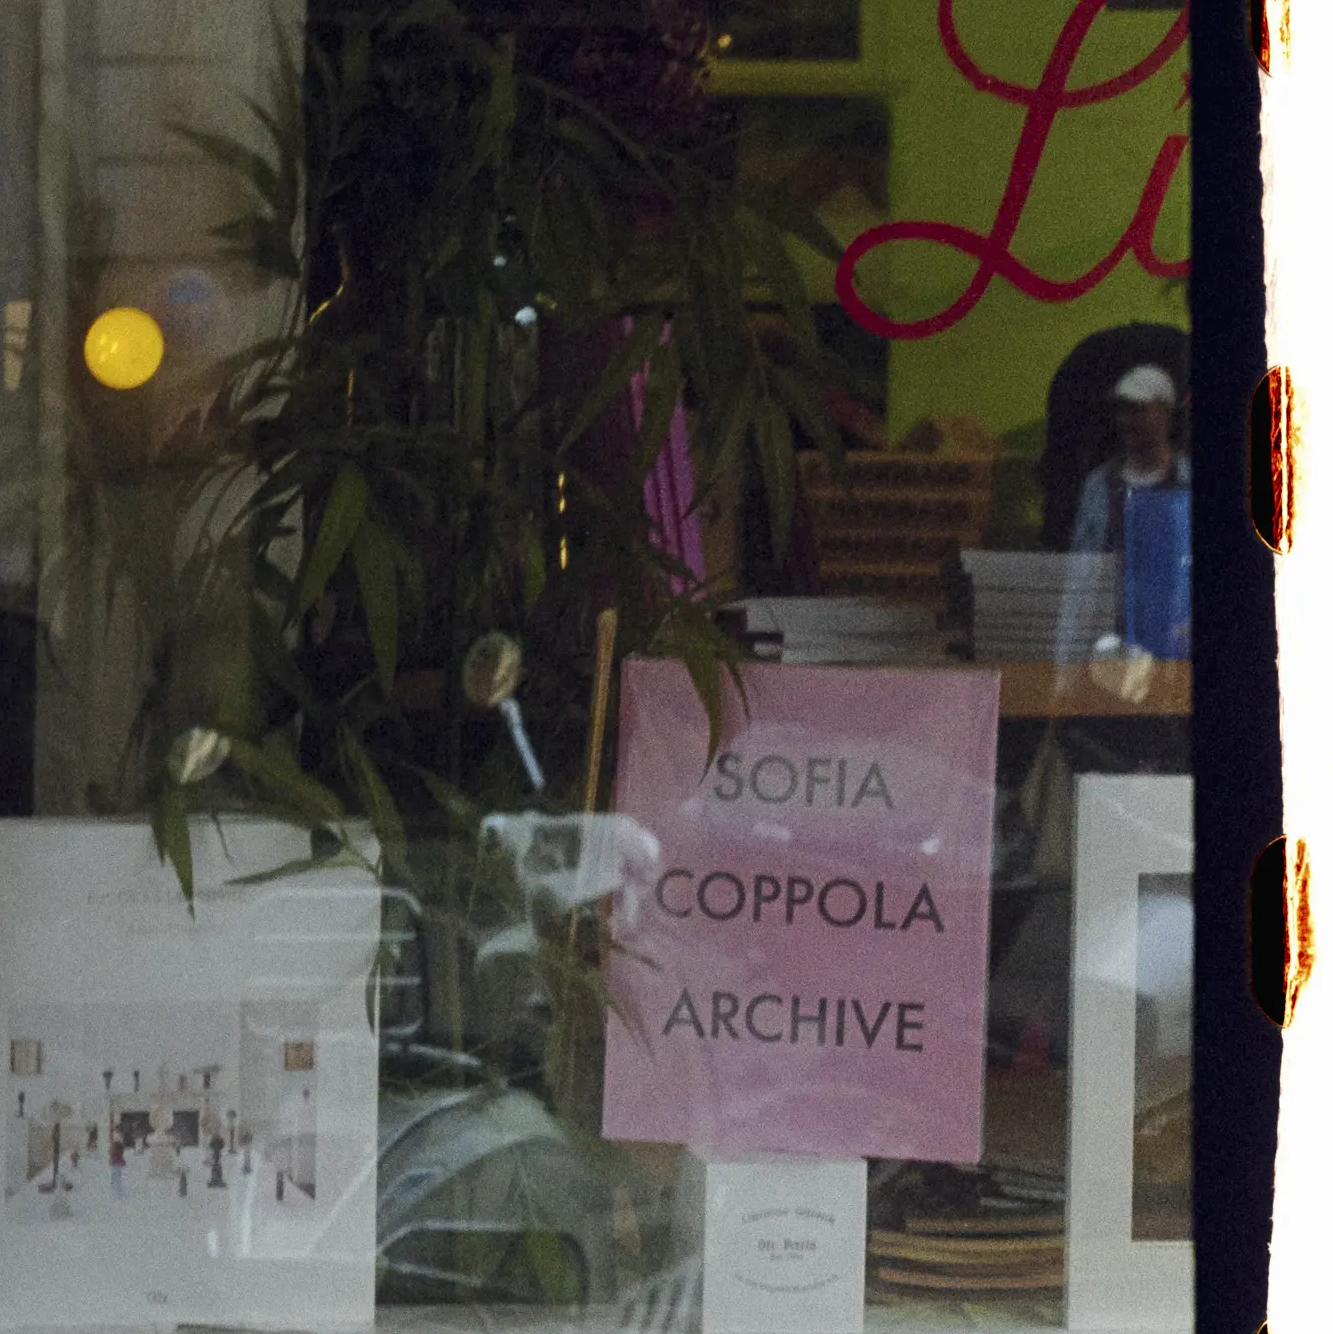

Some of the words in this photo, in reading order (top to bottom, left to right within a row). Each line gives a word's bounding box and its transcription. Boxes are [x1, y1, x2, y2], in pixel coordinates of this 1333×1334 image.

[712, 751, 895, 811] SOFIA
[656, 868, 945, 933] COPPOLA
[661, 986, 926, 1053] ARCHIVE
